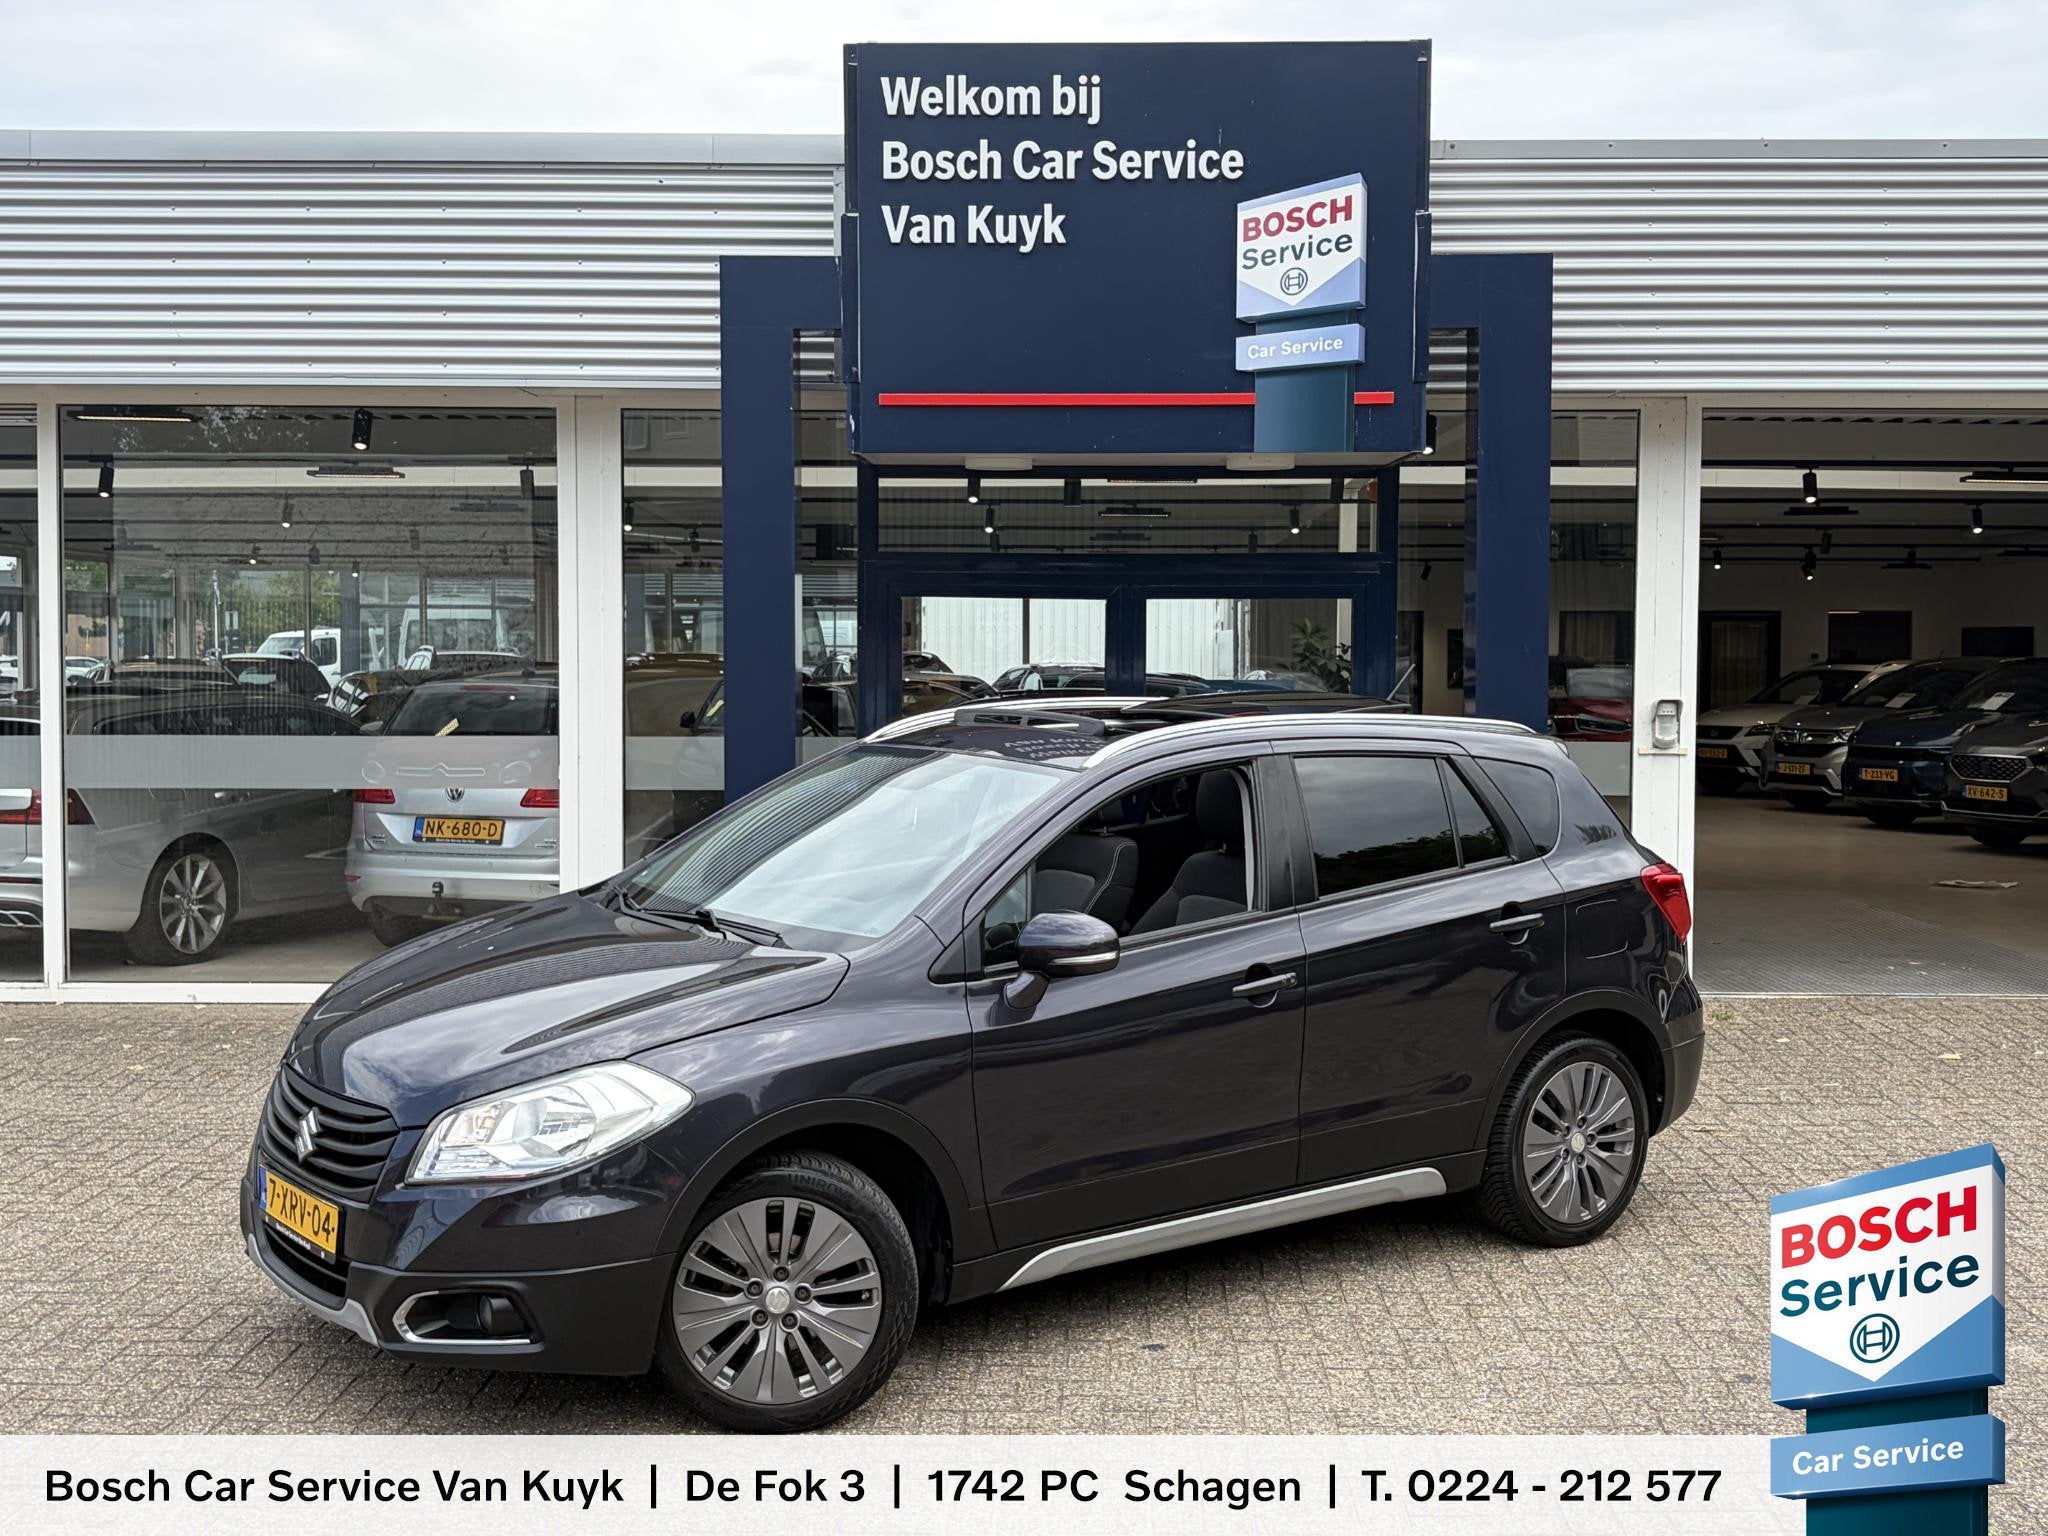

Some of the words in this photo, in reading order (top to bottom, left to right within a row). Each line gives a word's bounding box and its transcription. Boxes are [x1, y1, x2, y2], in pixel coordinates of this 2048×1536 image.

[880, 74, 1041, 116] Welkom
[1052, 74, 1101, 125] bij
[882, 138, 1002, 180] Bosch
[1012, 140, 1084, 180] Car
[1091, 138, 1244, 180] Service
[880, 204, 956, 244] Van
[967, 203, 1067, 253] Kuyk
[1243, 194, 1354, 242] BOSCH
[1242, 232, 1354, 271] Service
[1247, 343, 1276, 360] Car
[1280, 335, 1344, 356] Service
[424, 819, 498, 839] NK-680-D
[268, 1177, 333, 1243] 7-XRV-04
